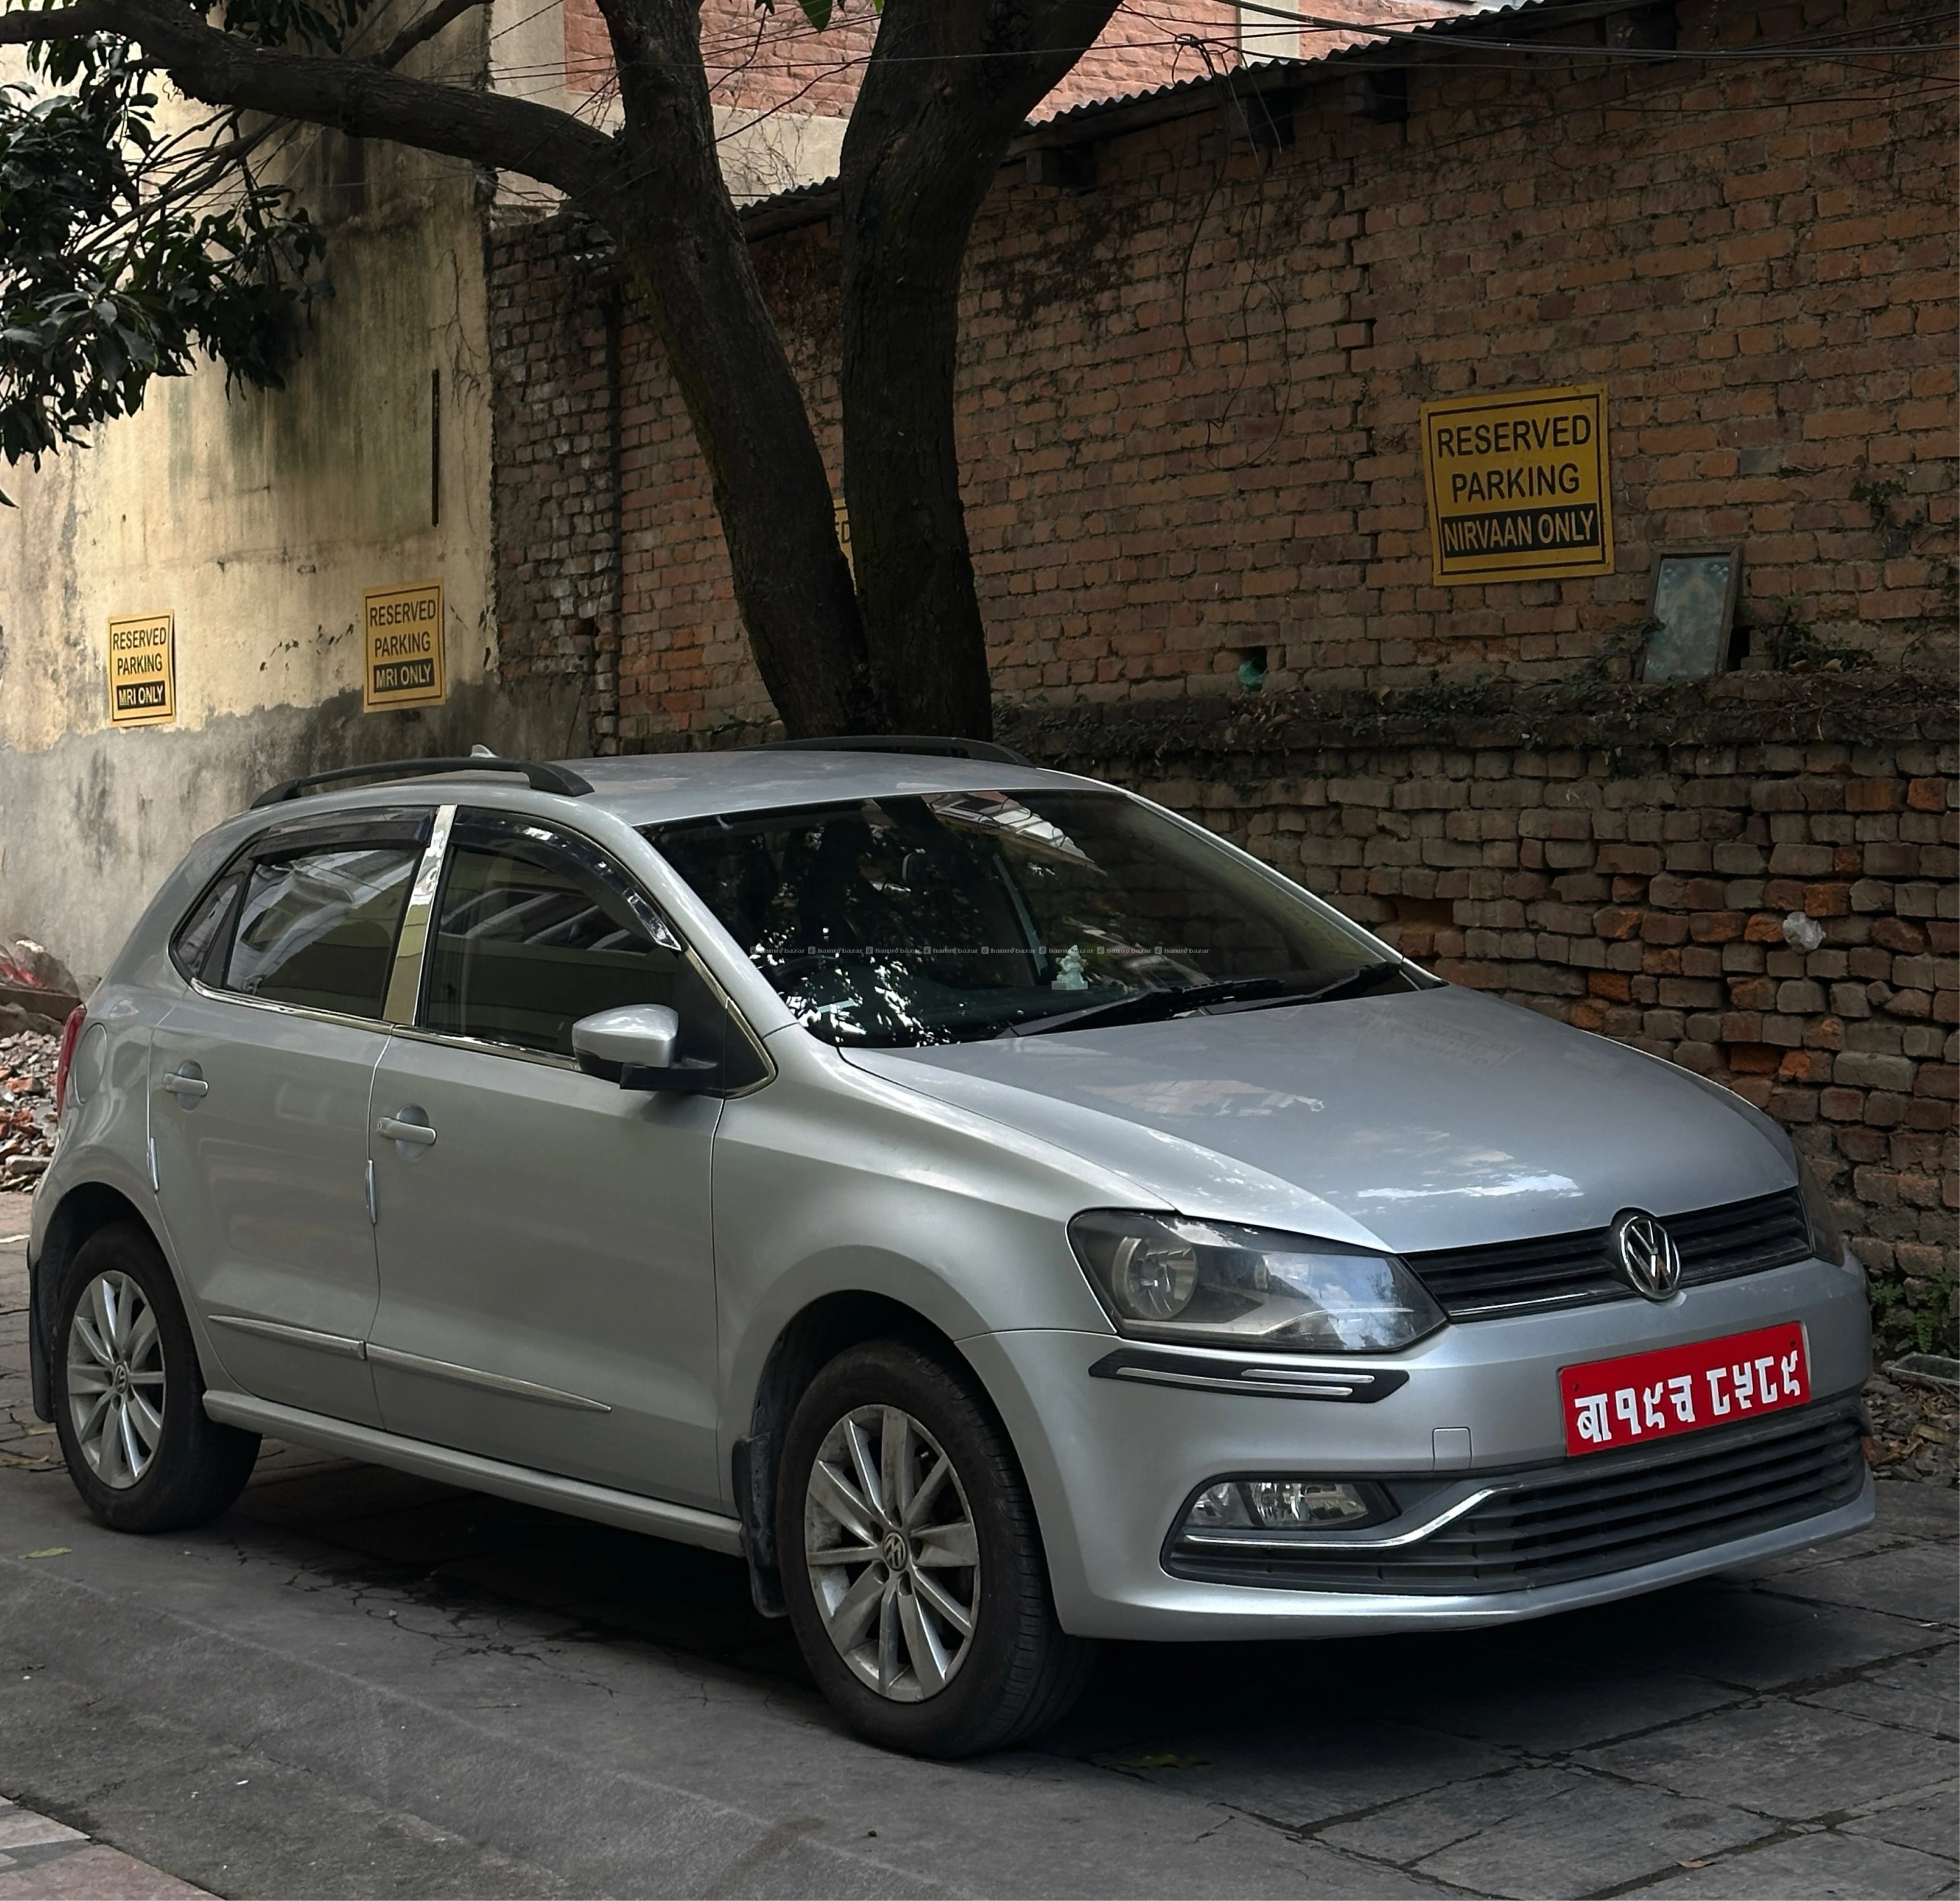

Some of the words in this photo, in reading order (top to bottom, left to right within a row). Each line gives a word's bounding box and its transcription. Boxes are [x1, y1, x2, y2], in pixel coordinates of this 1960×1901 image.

[1437, 414, 1591, 457] RESERVED
[1452, 462, 1580, 503] PARKING
[1444, 515, 1532, 552] NIRVAAN
[1538, 509, 1594, 544] ONLY
[370, 599, 436, 627] RESERVED
[113, 627, 166, 651] RESERVED
[374, 631, 431, 658] PARKING
[117, 653, 162, 676] PARKING
[376, 668, 398, 689] MRI
[400, 663, 431, 686] ONLY
[118, 688, 136, 706] MRI
[138, 685, 163, 704] ONLY
